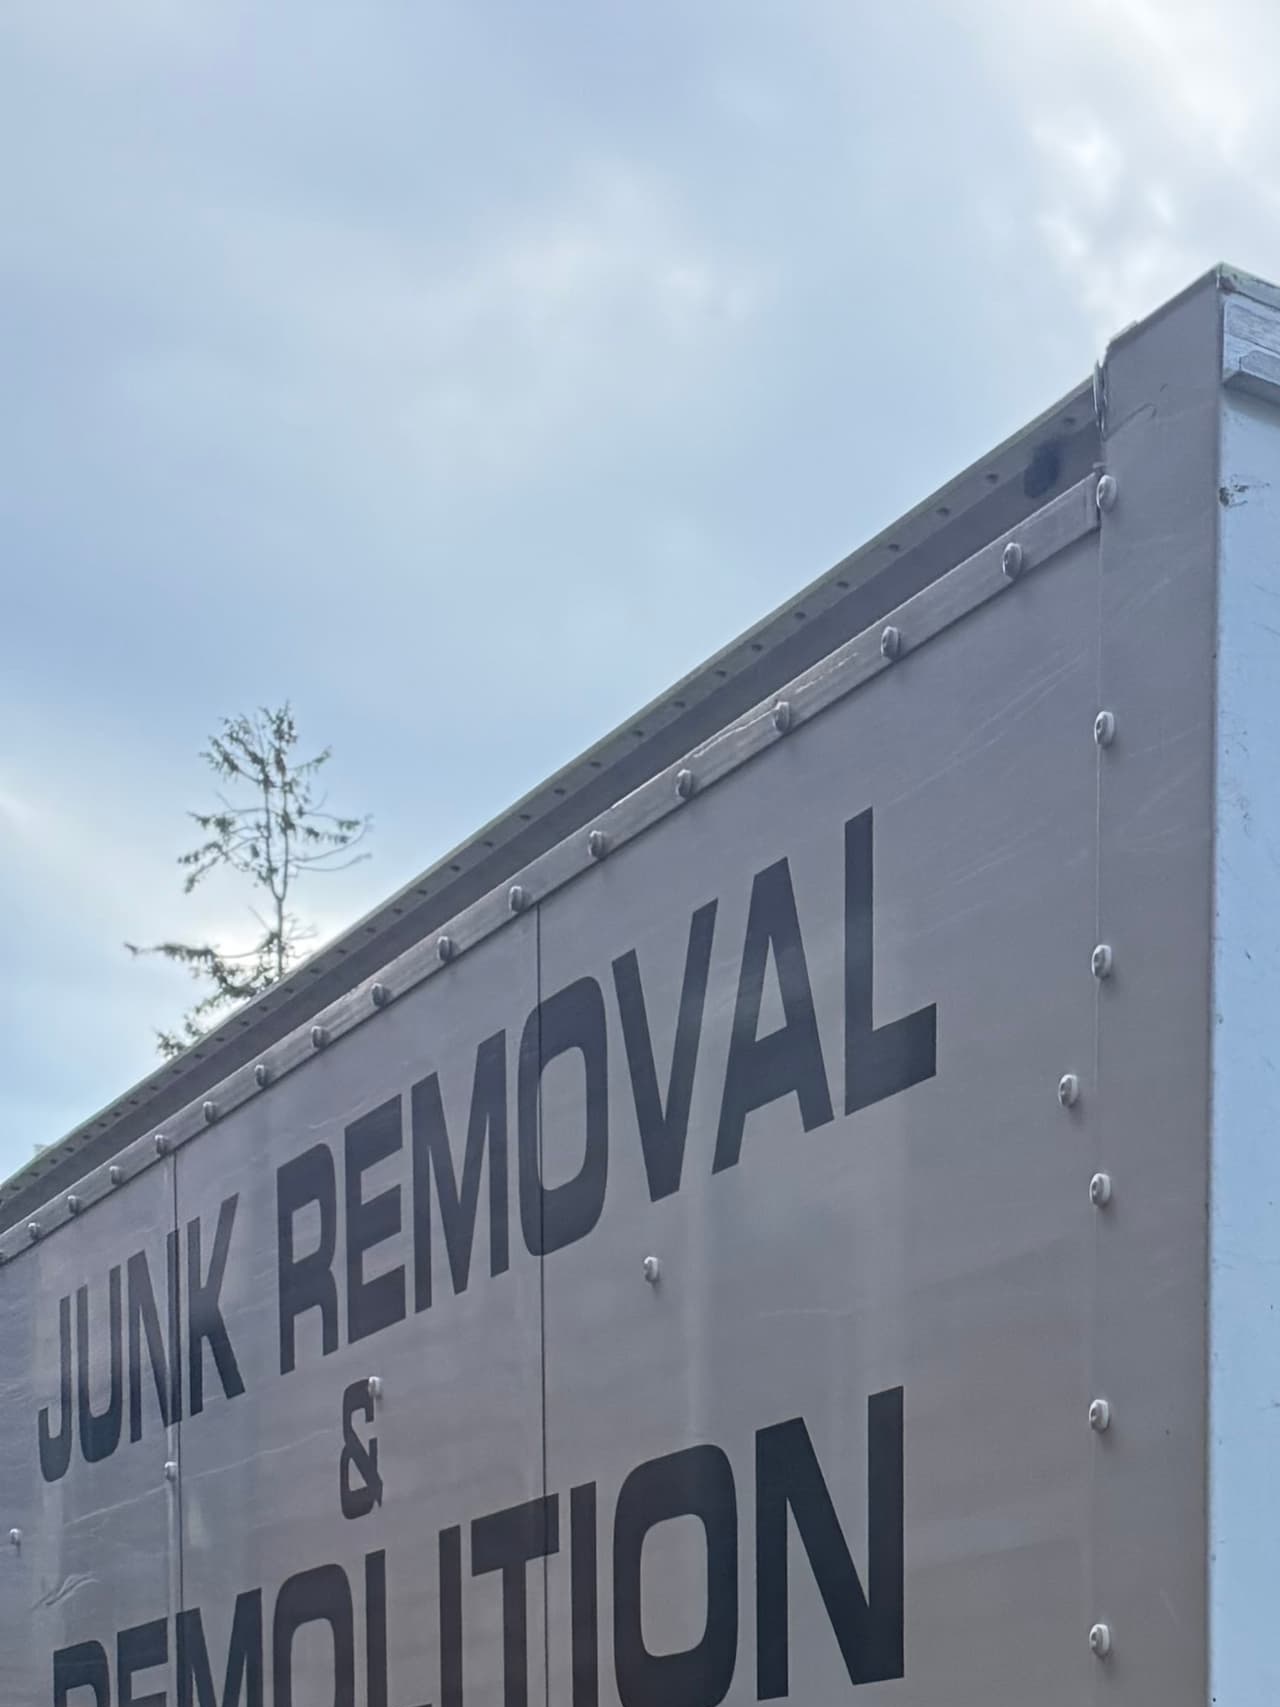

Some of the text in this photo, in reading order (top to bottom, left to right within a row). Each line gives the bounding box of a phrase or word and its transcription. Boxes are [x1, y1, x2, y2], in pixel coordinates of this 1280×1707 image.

[38, 807, 937, 1483] JUNK REMOVAL
[340, 1377, 383, 1519] &
